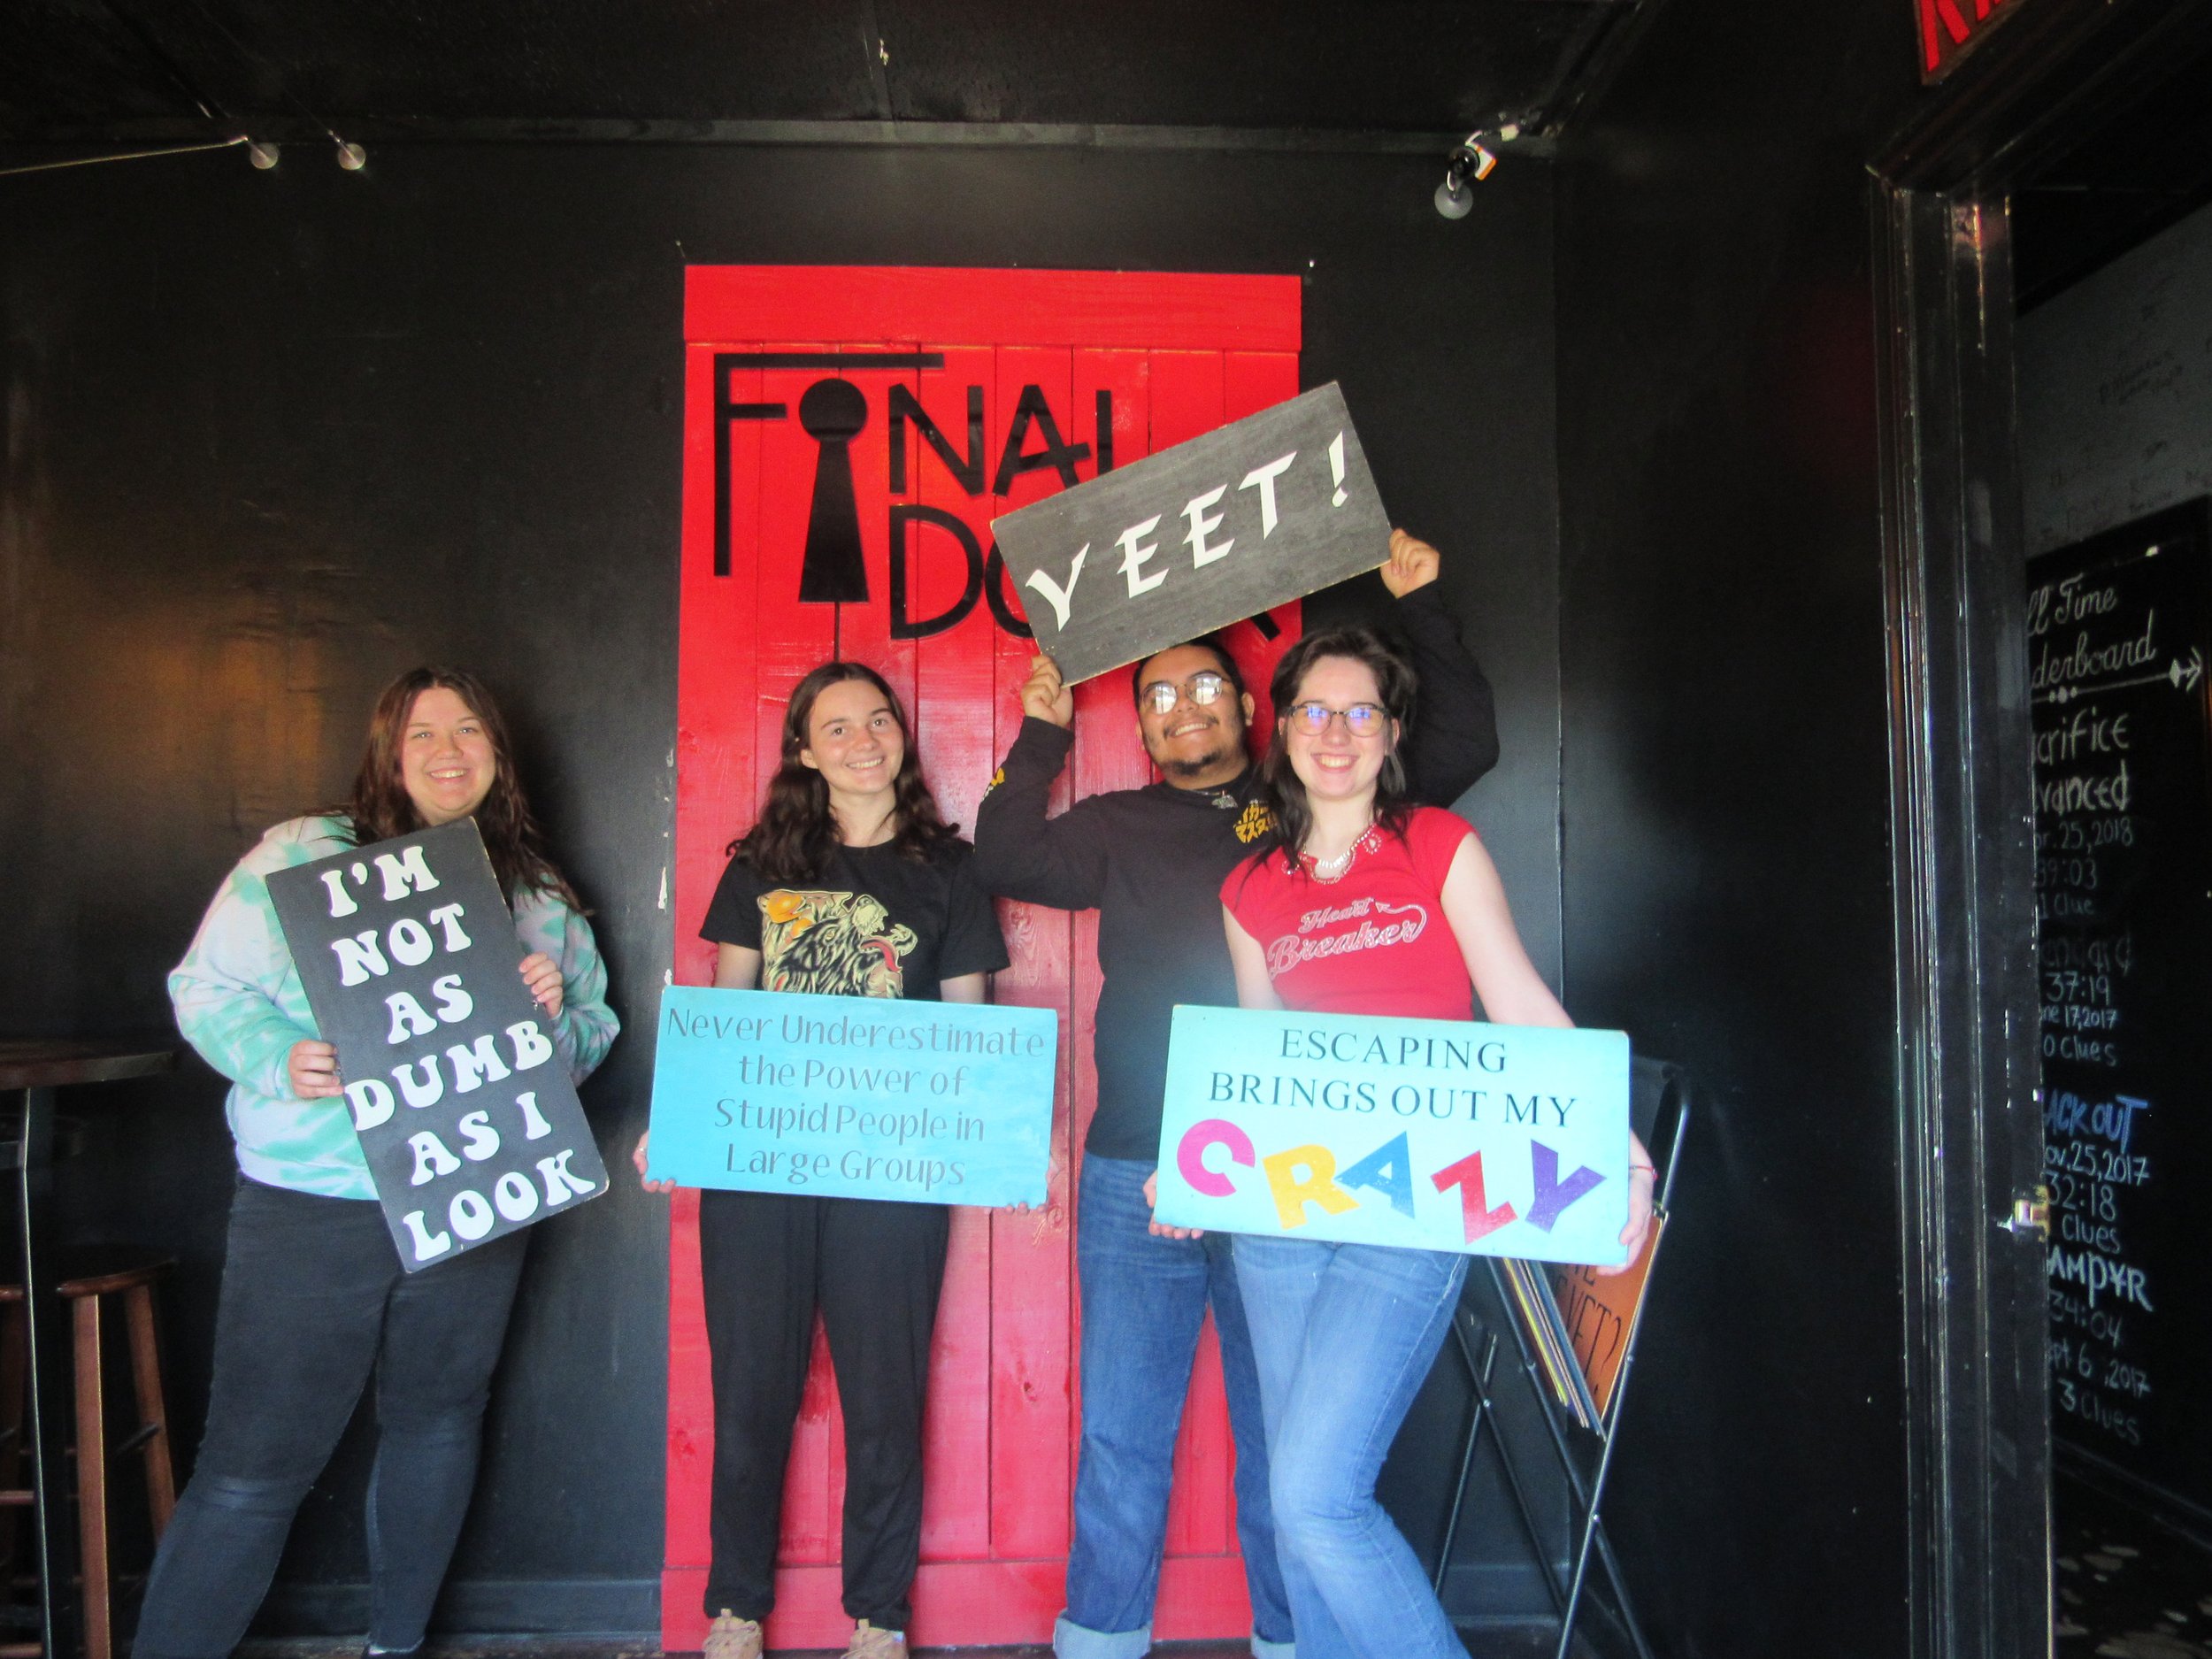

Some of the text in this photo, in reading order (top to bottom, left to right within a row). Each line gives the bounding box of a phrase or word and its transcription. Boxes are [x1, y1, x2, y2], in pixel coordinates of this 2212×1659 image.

[2027, 572, 2118, 636] ll Time
[2032, 608, 2157, 689] derboard
[2032, 706, 2130, 766] crifice
[2035, 759, 2131, 816] vanced
[321, 845, 440, 918] I'M
[2054, 893, 2095, 916] Clue
[330, 902, 472, 987] NOT
[1298, 897, 1375, 933] Heart
[1266, 920, 1419, 980] Breaker
[381, 973, 474, 1045] AS
[2045, 971, 2111, 1005] 37:19
[667, 1008, 1045, 1057] Never Underestimate
[1279, 1028, 1508, 1073] ESCAPING
[2060, 1034, 2116, 1067] Clues
[343, 1020, 553, 1132] DUMB
[740, 1055, 970, 1096] the Power of
[1209, 1071, 1578, 1128] BRINGS OUT MY
[407, 1091, 552, 1187] AS I
[715, 1097, 985, 1146] Stupid People in
[2044, 1088, 2149, 1154] ACKOUT
[726, 1143, 966, 1192] Large Groups
[1176, 1118, 1608, 1246] CRAZY
[2040, 1168, 2117, 1222] 32:18
[403, 1148, 596, 1262] LOOK
[2062, 1213, 2123, 1255] Clues
[2047, 1244, 2156, 1312] AMPYR
[2050, 1288, 2123, 1350] 34:04
[2078, 1340, 2092, 1379] 6
[2057, 1377, 2140, 1447] 3 Clues
